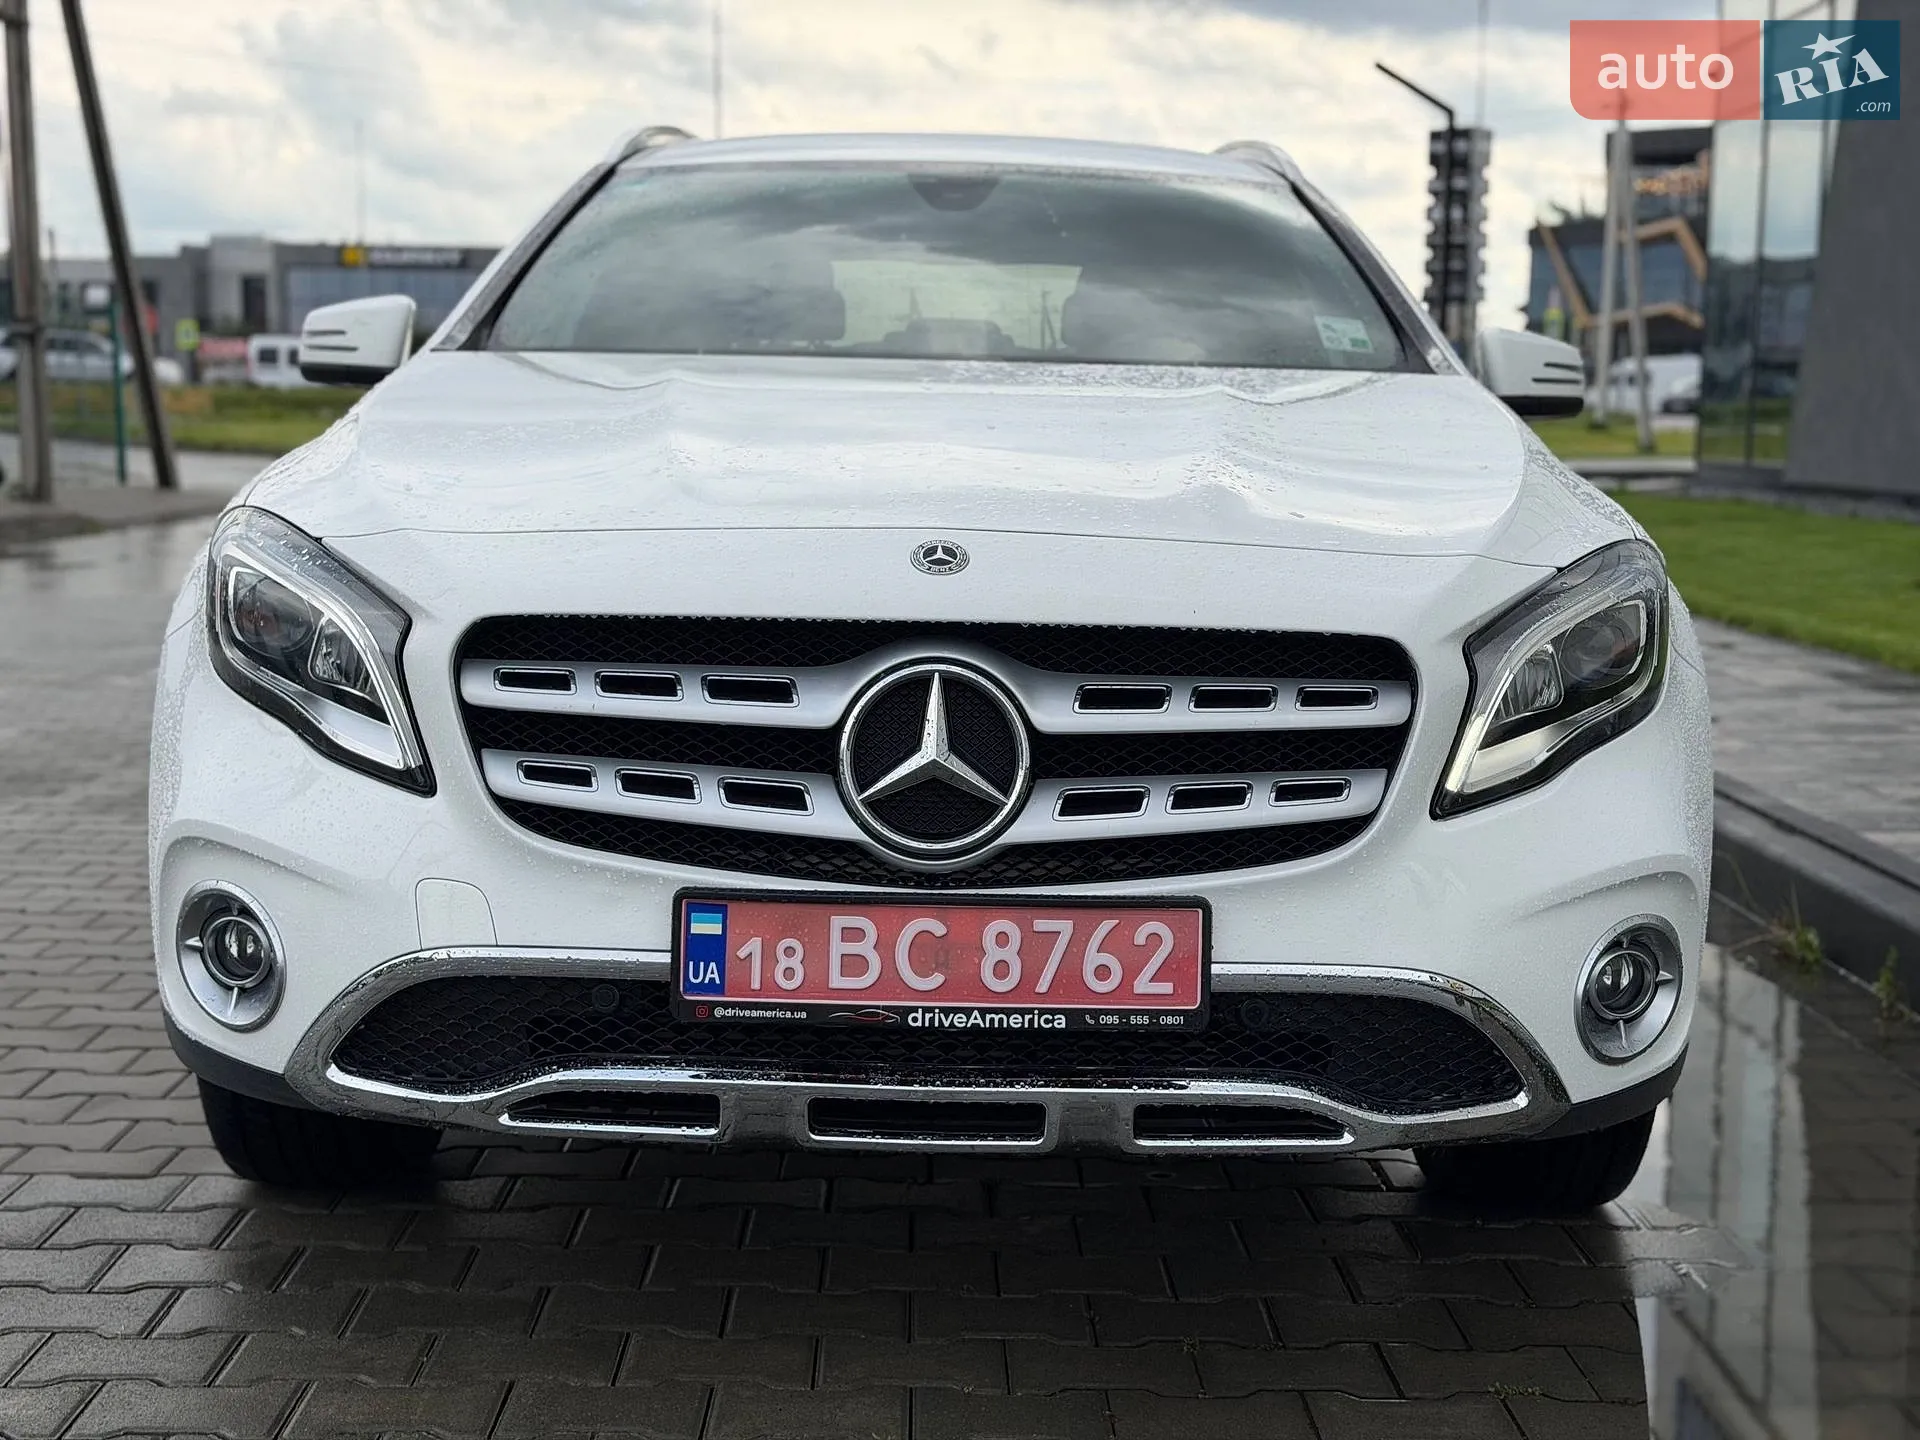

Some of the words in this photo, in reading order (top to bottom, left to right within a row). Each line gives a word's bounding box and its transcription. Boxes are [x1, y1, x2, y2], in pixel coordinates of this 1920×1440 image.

[736, 937, 805, 991] 18
[828, 915, 948, 991] BC
[980, 919, 1175, 995] 8762
[688, 961, 721, 985] UA
[713, 1006, 807, 1019] @driveamerica.ua
[907, 1008, 1067, 1028] driveAmerica
[1099, 1015, 1119, 1024] 095
[1130, 1015, 1150, 1025] 555
[1160, 1015, 1184, 1025] 0801
